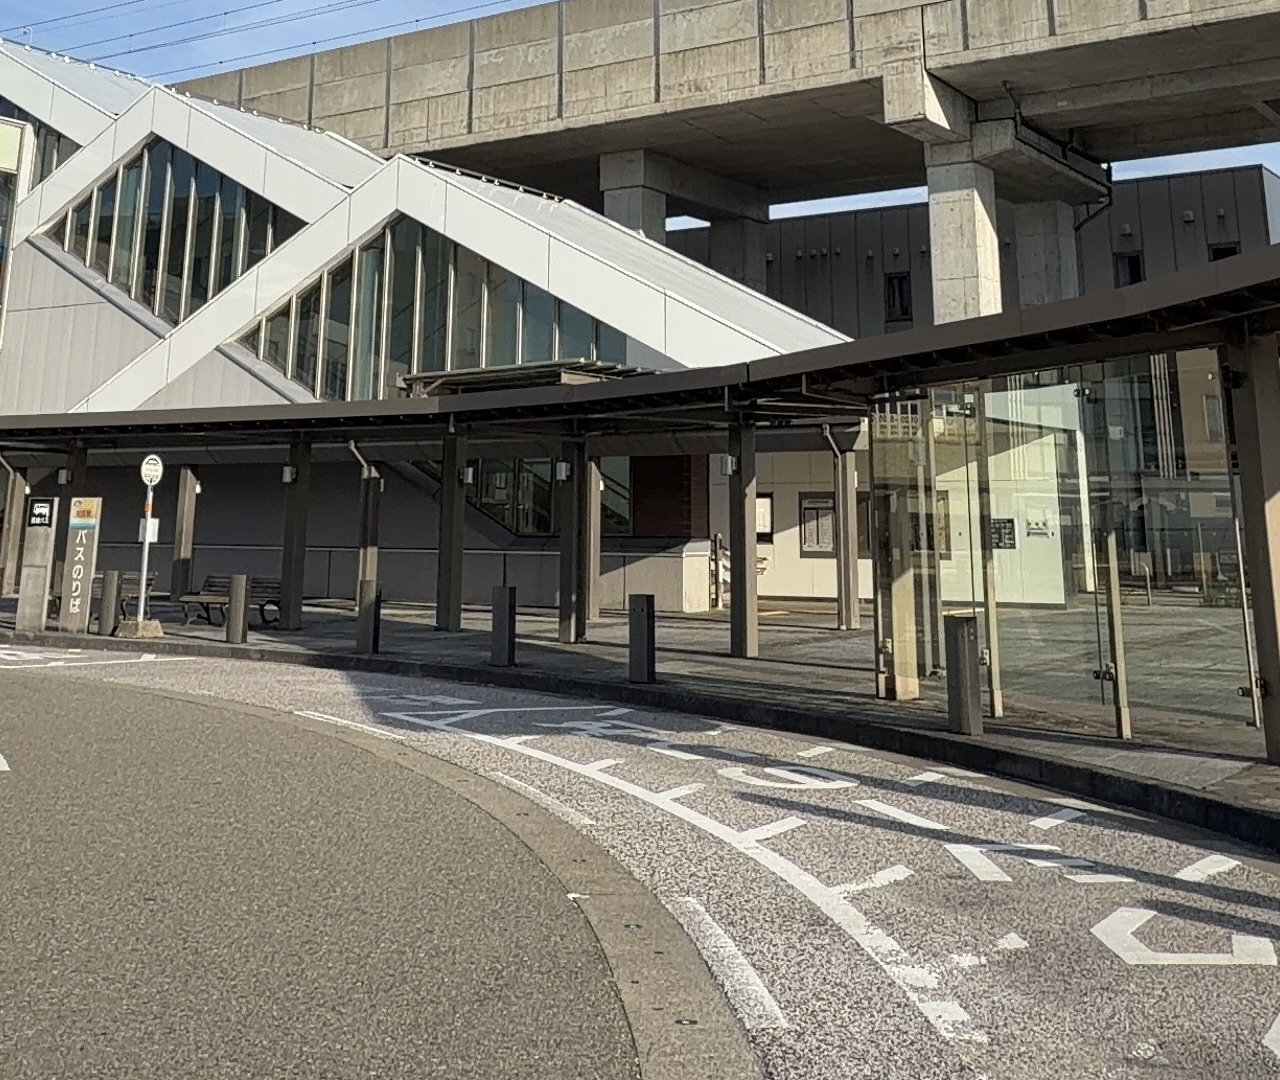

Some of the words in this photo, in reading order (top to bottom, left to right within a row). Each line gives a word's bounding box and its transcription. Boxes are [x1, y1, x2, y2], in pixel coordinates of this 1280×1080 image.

[69, 530, 88, 614] バスのりば
